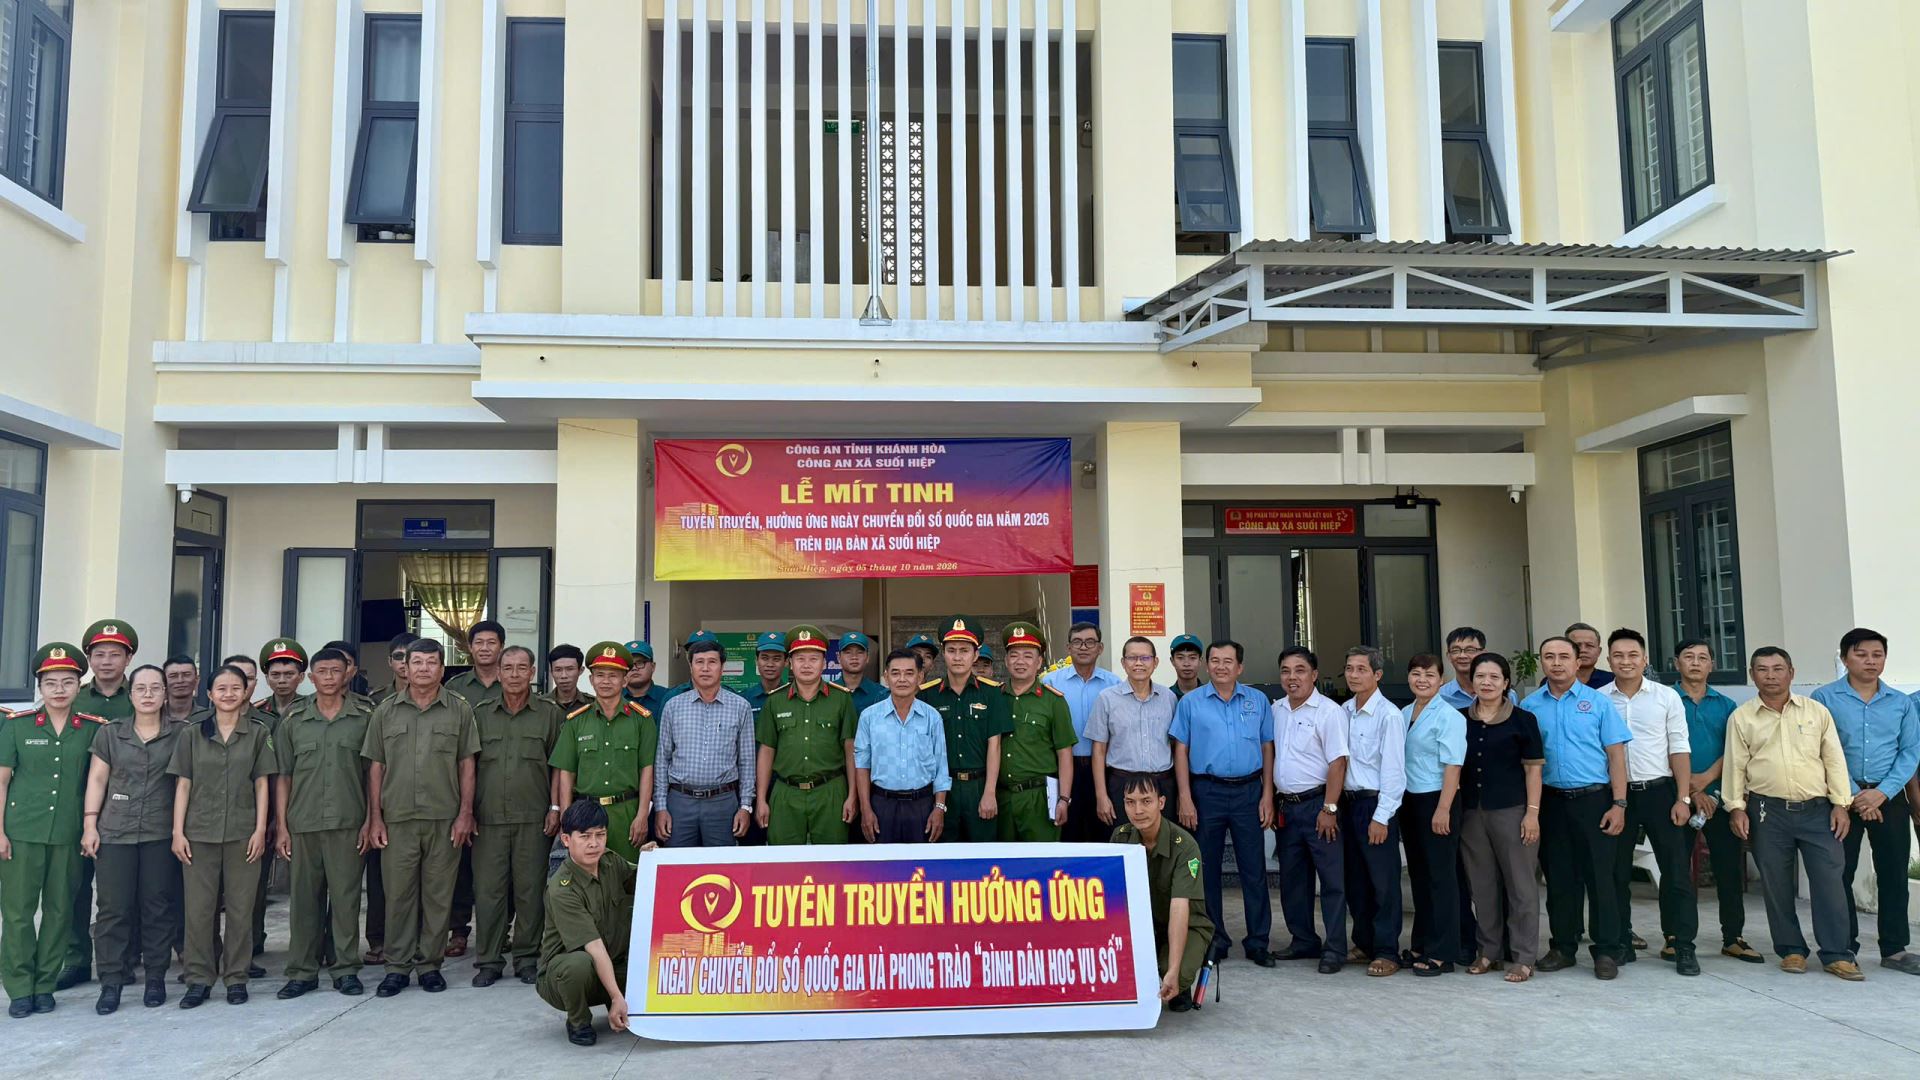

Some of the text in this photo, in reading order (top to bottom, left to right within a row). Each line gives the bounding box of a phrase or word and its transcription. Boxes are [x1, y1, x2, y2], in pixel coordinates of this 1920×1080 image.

[786, 443, 946, 454] CÔNG AN TỈNH KHÁNH HÒA
[797, 456, 936, 469] CÔNG AN XÃ SUỐI HIỆP
[780, 477, 954, 504] LỄ MÍT TINH
[680, 513, 715, 530] TUYÊN
[766, 511, 803, 529] HƯỞNG
[805, 512, 828, 529] ỨNG
[831, 512, 859, 529] NGÀY
[862, 510, 904, 528] CHUYỂN
[907, 509, 925, 527] ĐỔI
[928, 509, 943, 527] SỐ
[945, 509, 973, 528] QUỐC
[976, 513, 994, 527] GIA
[996, 511, 1021, 526] NĂM
[1024, 512, 1050, 526] 2026
[1238, 519, 1341, 532] CÔNG AN XÃ SUỐI HIỆP
[794, 532, 941, 553] TRÊN ĐỊA BÀN XÃ SUỐI HIỆP
[830, 565, 854, 574] ngày
[869, 563, 898, 572] tháng
[901, 563, 911, 571] 10
[913, 563, 934, 571] năm
[936, 562, 958, 570] 2026
[751, 865, 1105, 928] TUYÊN TRUYỀN HƯỞNG ỨNG
[657, 933, 1123, 997] NGÀY CHUYỂN ĐỔI SỐ QUỐC GIA VÀ PHONG TRÀO “BÌNH DÂN HỌC VỤ SỐ”
